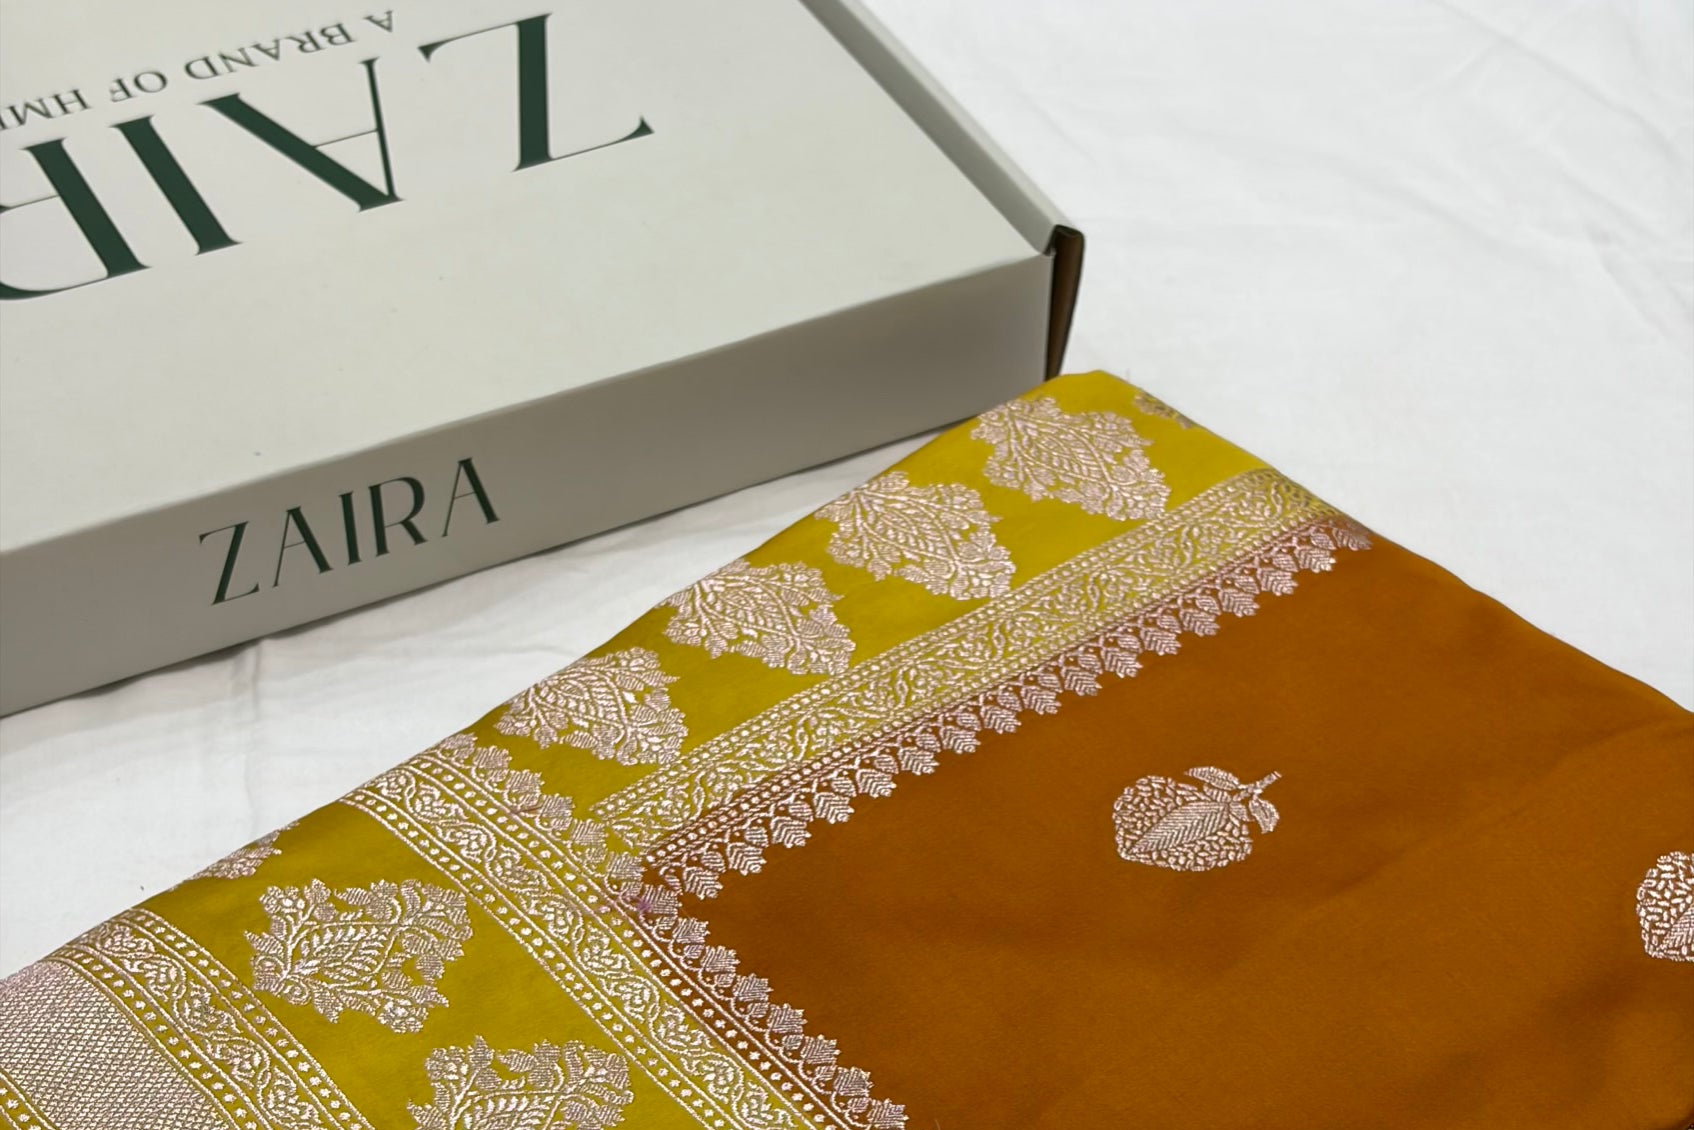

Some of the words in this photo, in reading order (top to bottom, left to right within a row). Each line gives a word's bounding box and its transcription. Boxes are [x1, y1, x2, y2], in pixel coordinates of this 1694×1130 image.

[362, 9, 394, 33] A
[184, 22, 357, 80] BRAND
[108, 70, 168, 103] OF
[198, 457, 500, 606] ZAIRA
